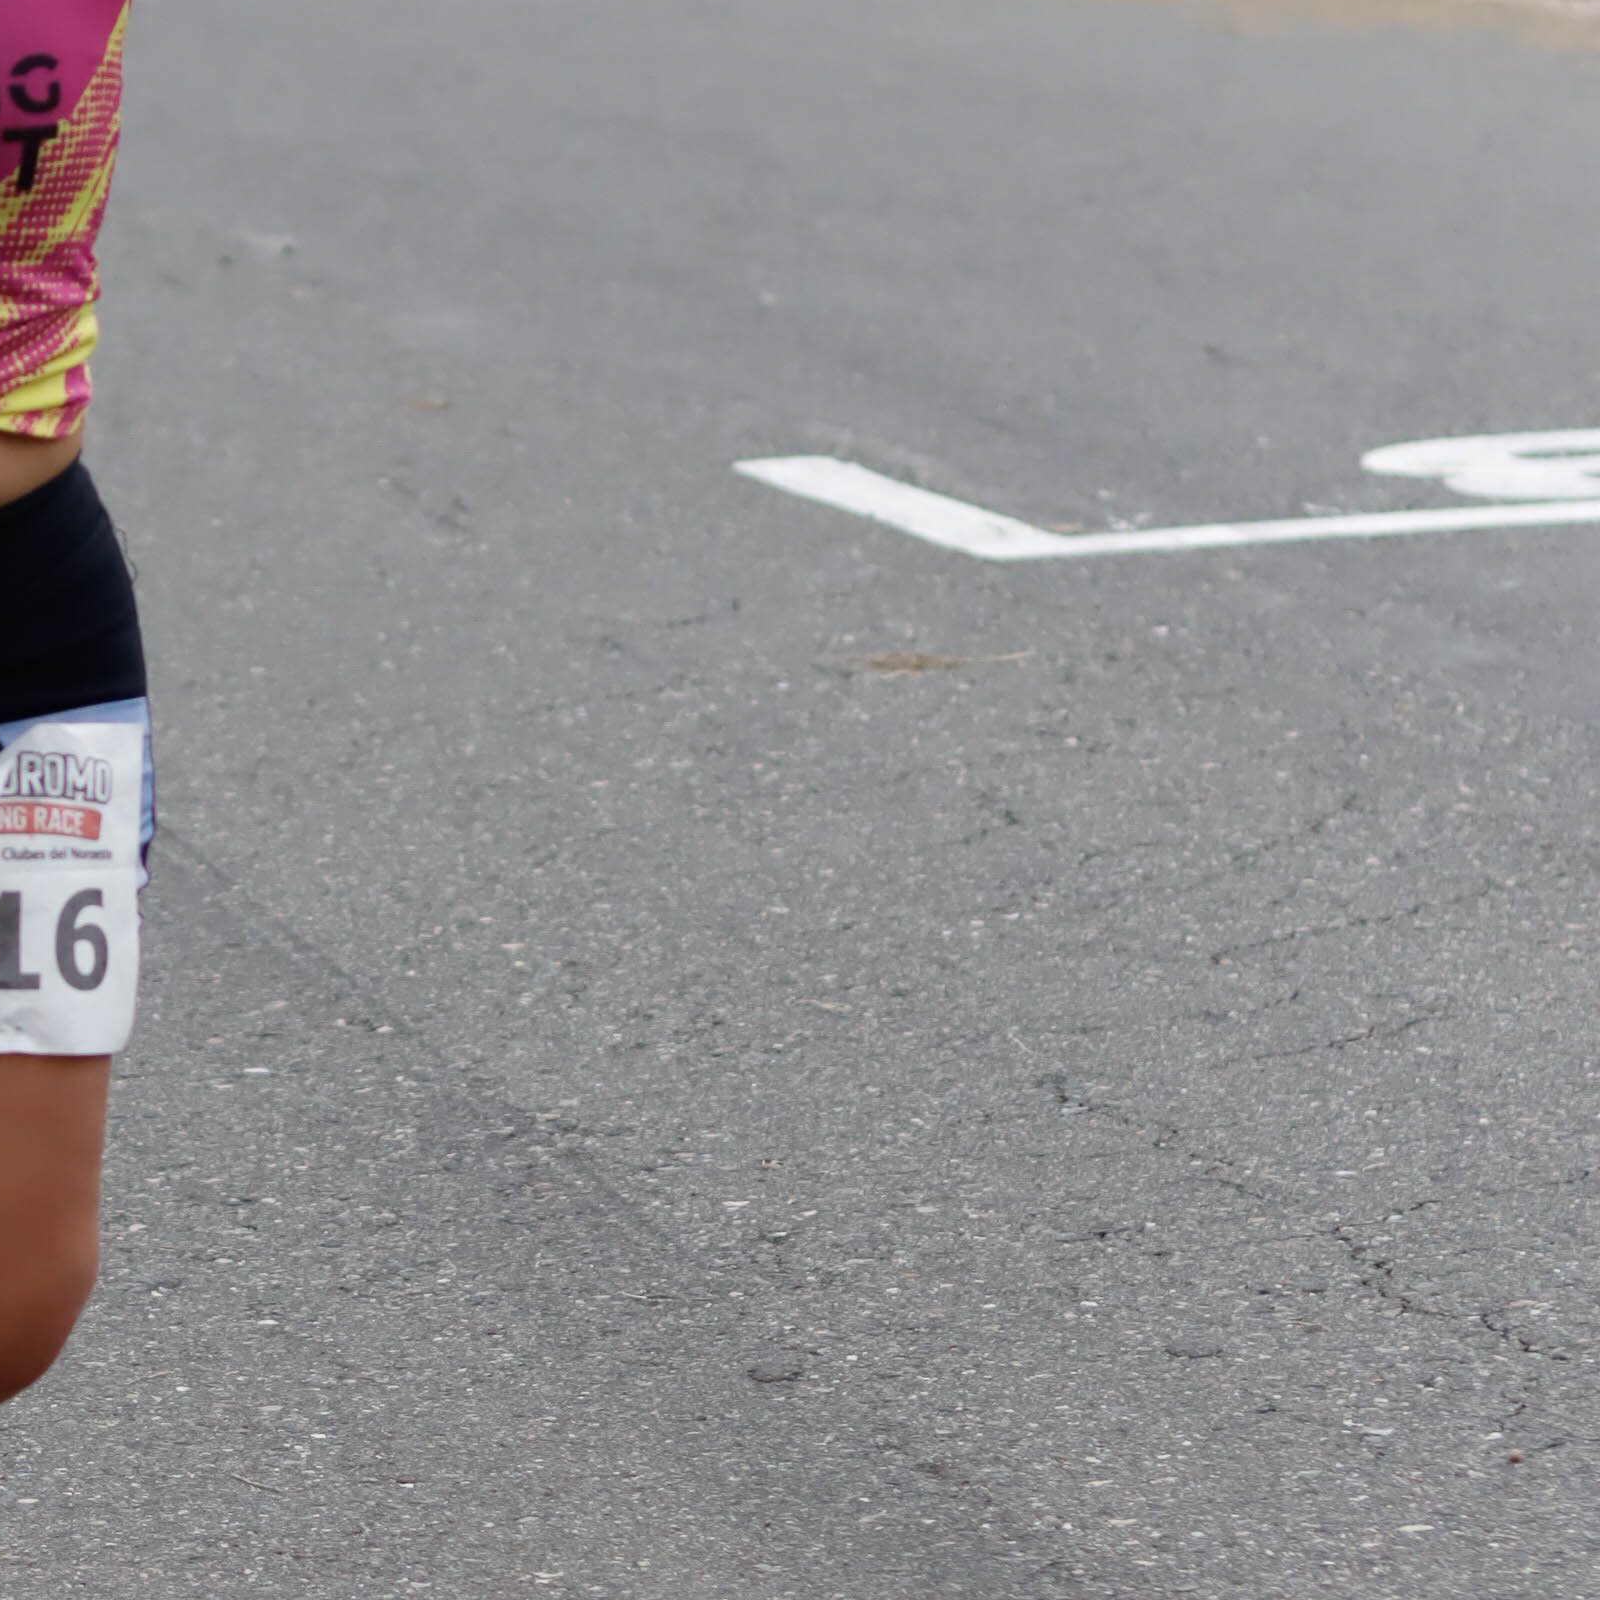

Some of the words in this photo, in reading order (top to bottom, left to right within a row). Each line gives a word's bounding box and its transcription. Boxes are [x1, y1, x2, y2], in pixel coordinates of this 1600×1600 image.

[33, 805, 86, 836] RACE
[1, 846, 45, 861] Clubes
[50, 846, 67, 860] del
